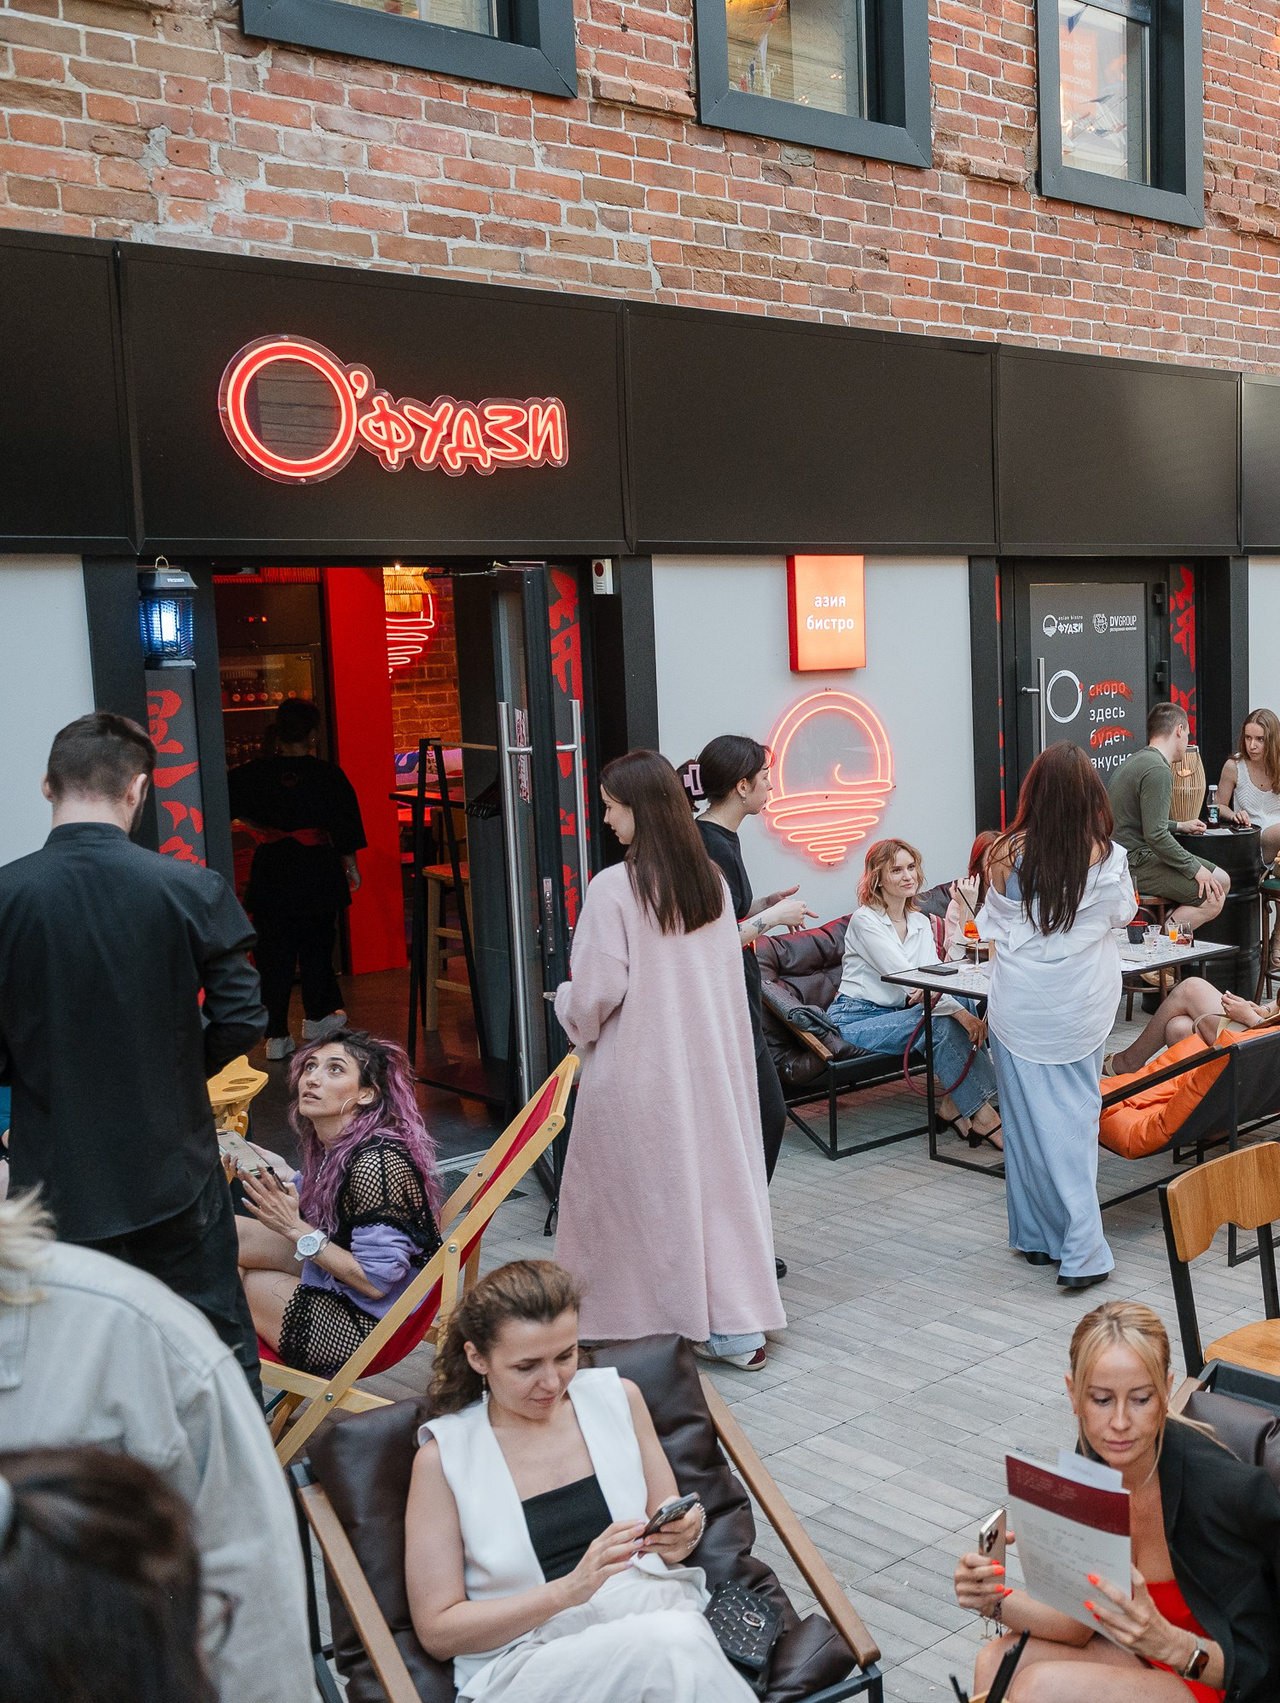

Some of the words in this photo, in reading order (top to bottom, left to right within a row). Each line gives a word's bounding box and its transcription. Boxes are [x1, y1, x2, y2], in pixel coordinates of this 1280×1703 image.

[814, 595, 846, 608] азия
[806, 614, 854, 633] бистро
[1088, 682, 1126, 699] скоро
[1089, 706, 1126, 723] здесь
[1089, 729, 1126, 749] будет
